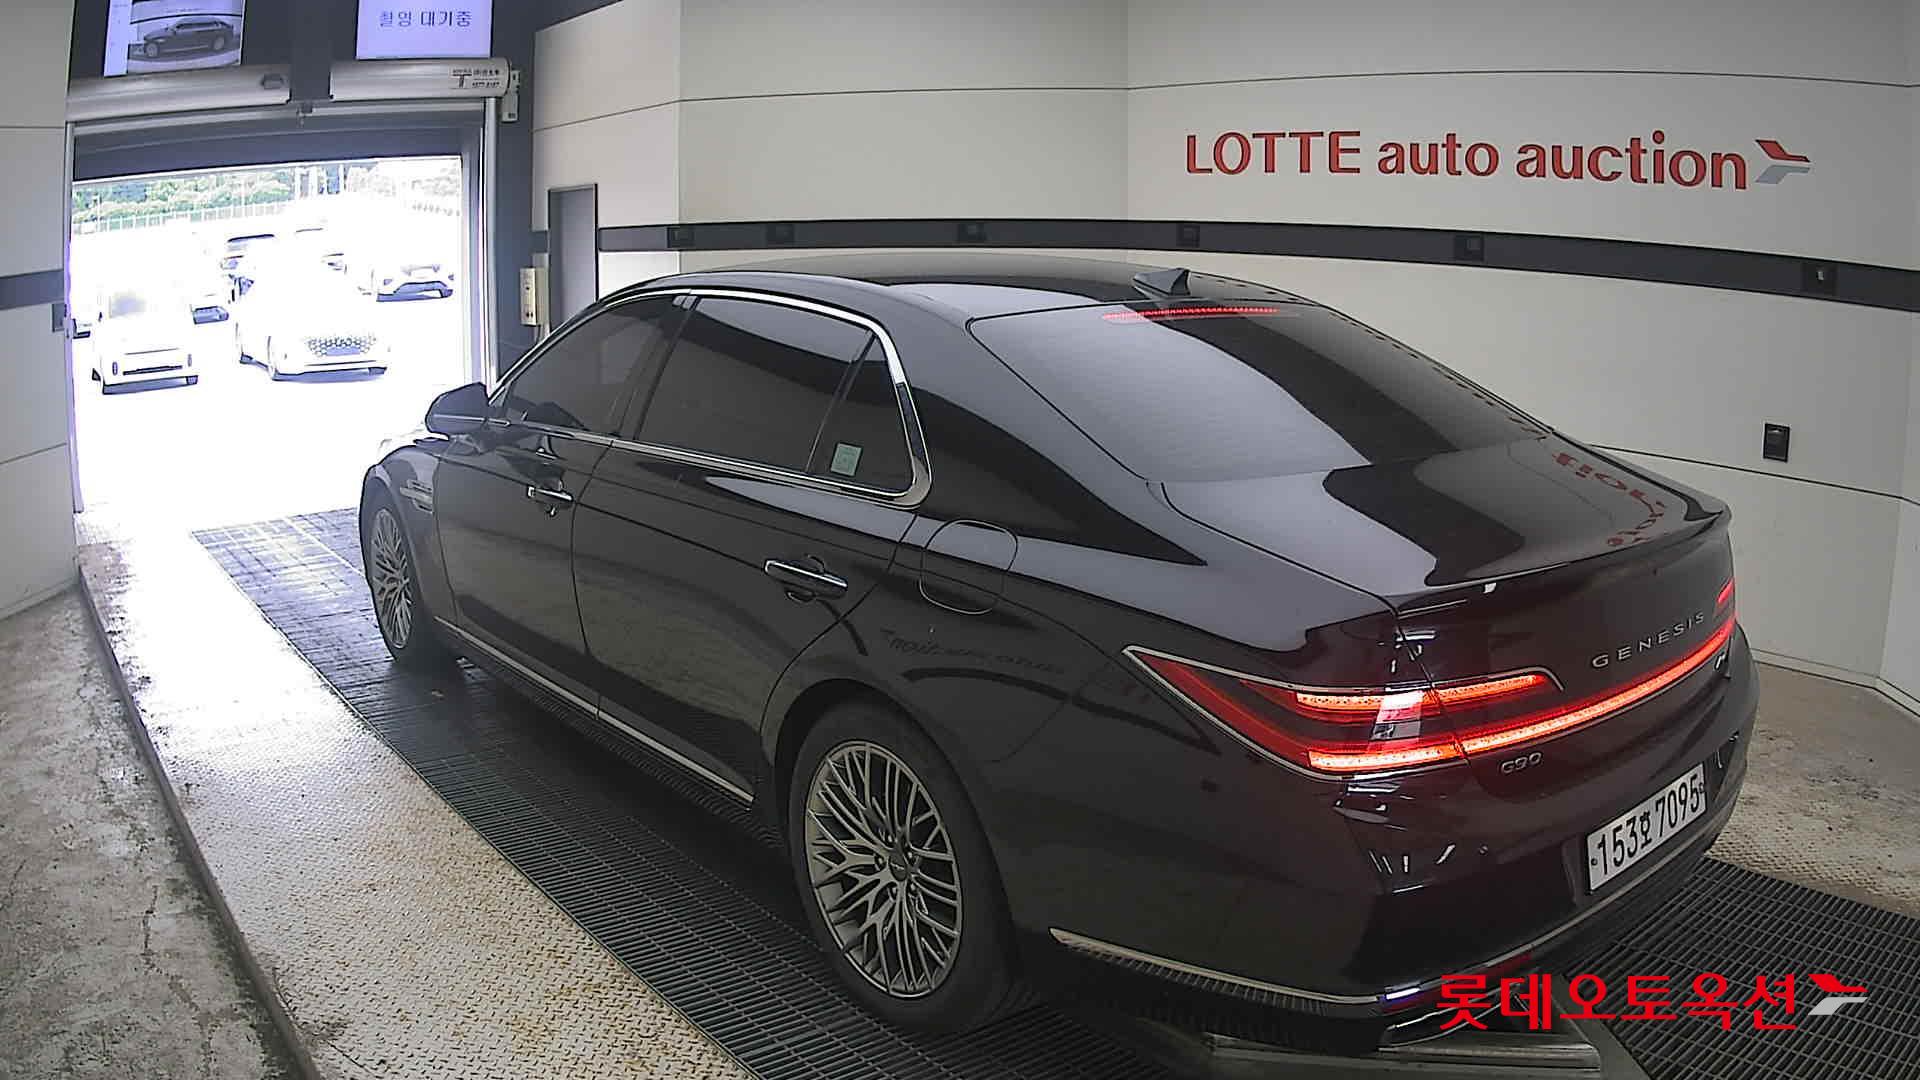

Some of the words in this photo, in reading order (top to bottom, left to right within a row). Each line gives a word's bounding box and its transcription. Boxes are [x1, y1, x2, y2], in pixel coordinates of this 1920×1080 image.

[420, 10, 473, 28] 대기중
[1185, 130, 1361, 175] LOTTE
[1377, 132, 1500, 178] auto
[1515, 130, 1748, 190] auction
[1591, 611, 1705, 669] GENESIS
[1501, 751, 1542, 774] G90
[1597, 810, 1653, 876] 153호
[1655, 774, 1700, 838] 7095
